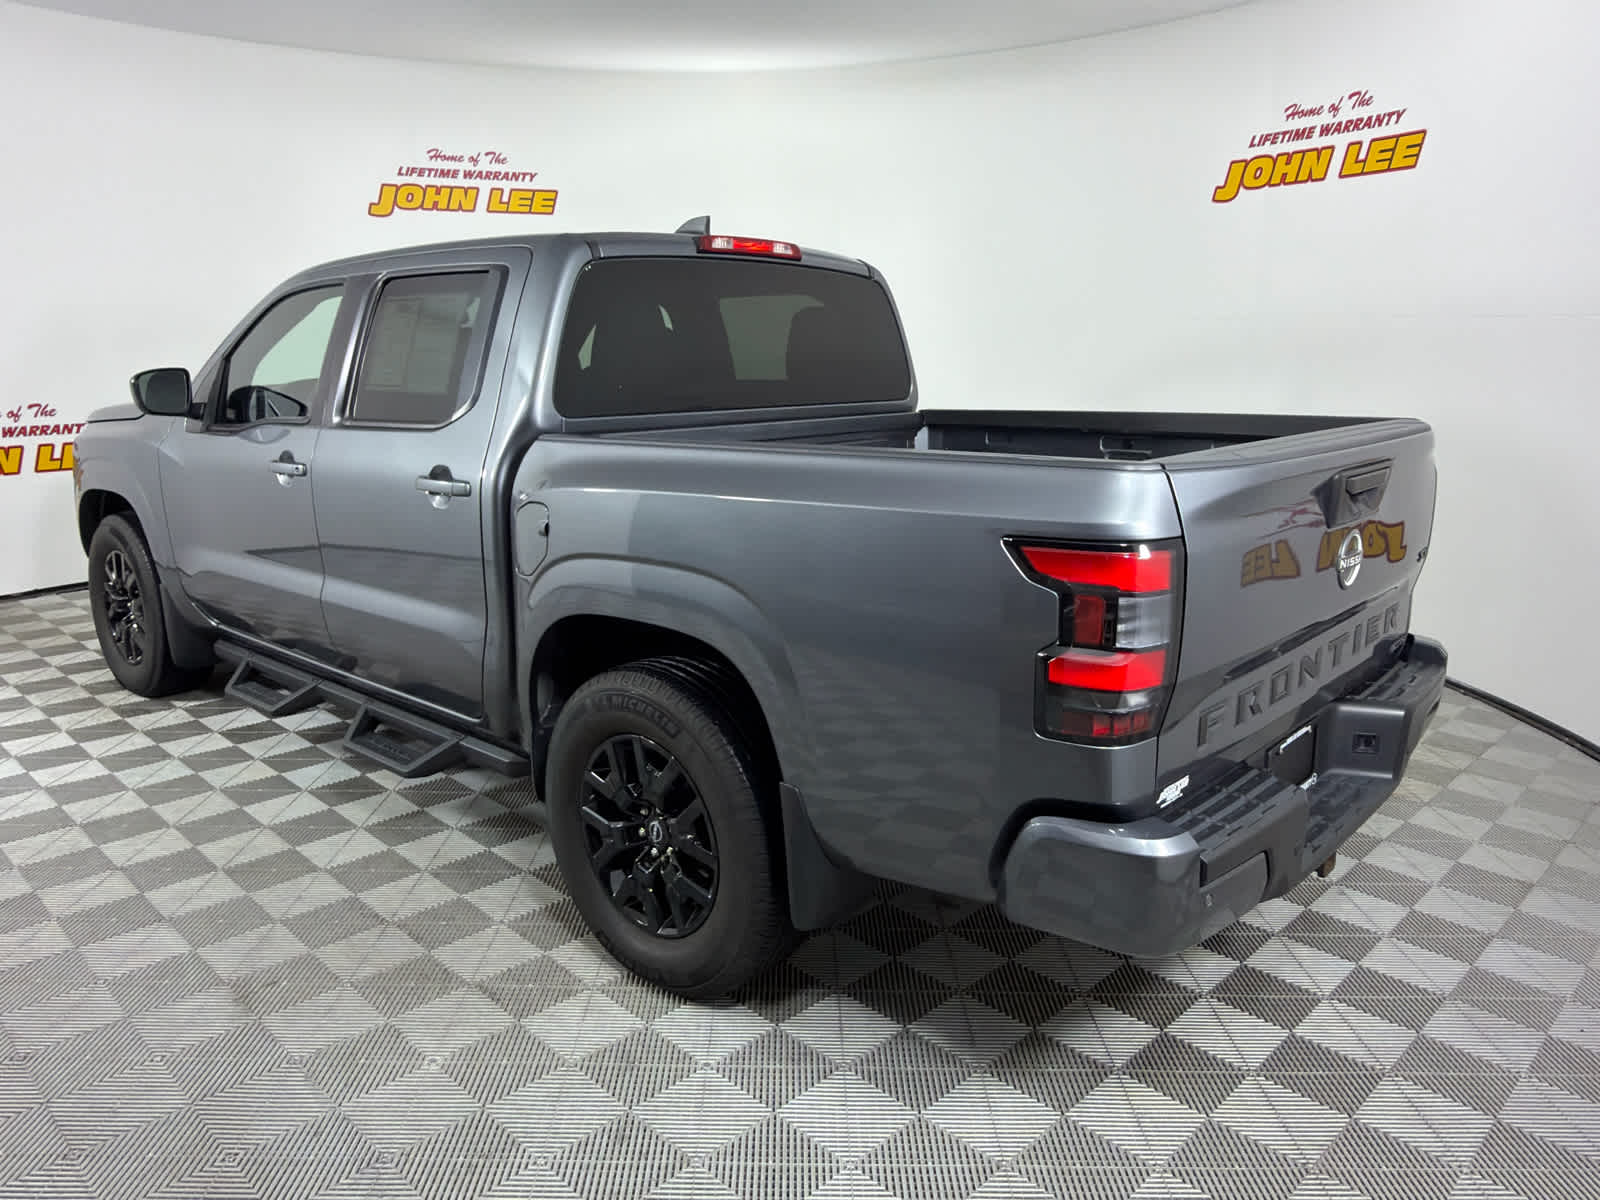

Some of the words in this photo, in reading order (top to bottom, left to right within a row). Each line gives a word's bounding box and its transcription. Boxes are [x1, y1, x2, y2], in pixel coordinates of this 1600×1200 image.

[1284, 103, 1324, 121] Home
[1328, 96, 1344, 118] of
[1347, 89, 1374, 110] The
[1248, 126, 1316, 148] LIFETIME
[1318, 107, 1407, 138] WARRANTY
[426, 148, 465, 163] Home
[468, 152, 481, 166] of
[484, 151, 509, 165] The
[1211, 145, 1335, 204] JOHN
[1338, 129, 1427, 179] LEE
[397, 166, 460, 179] LIFETIME
[462, 169, 538, 183] WARRANTY
[368, 183, 480, 217] JOHN
[486, 187, 558, 215] LEE
[6, 405, 22, 423] of
[27, 403, 57, 418] The
[1197, 602, 1400, 748] FRONTIER
